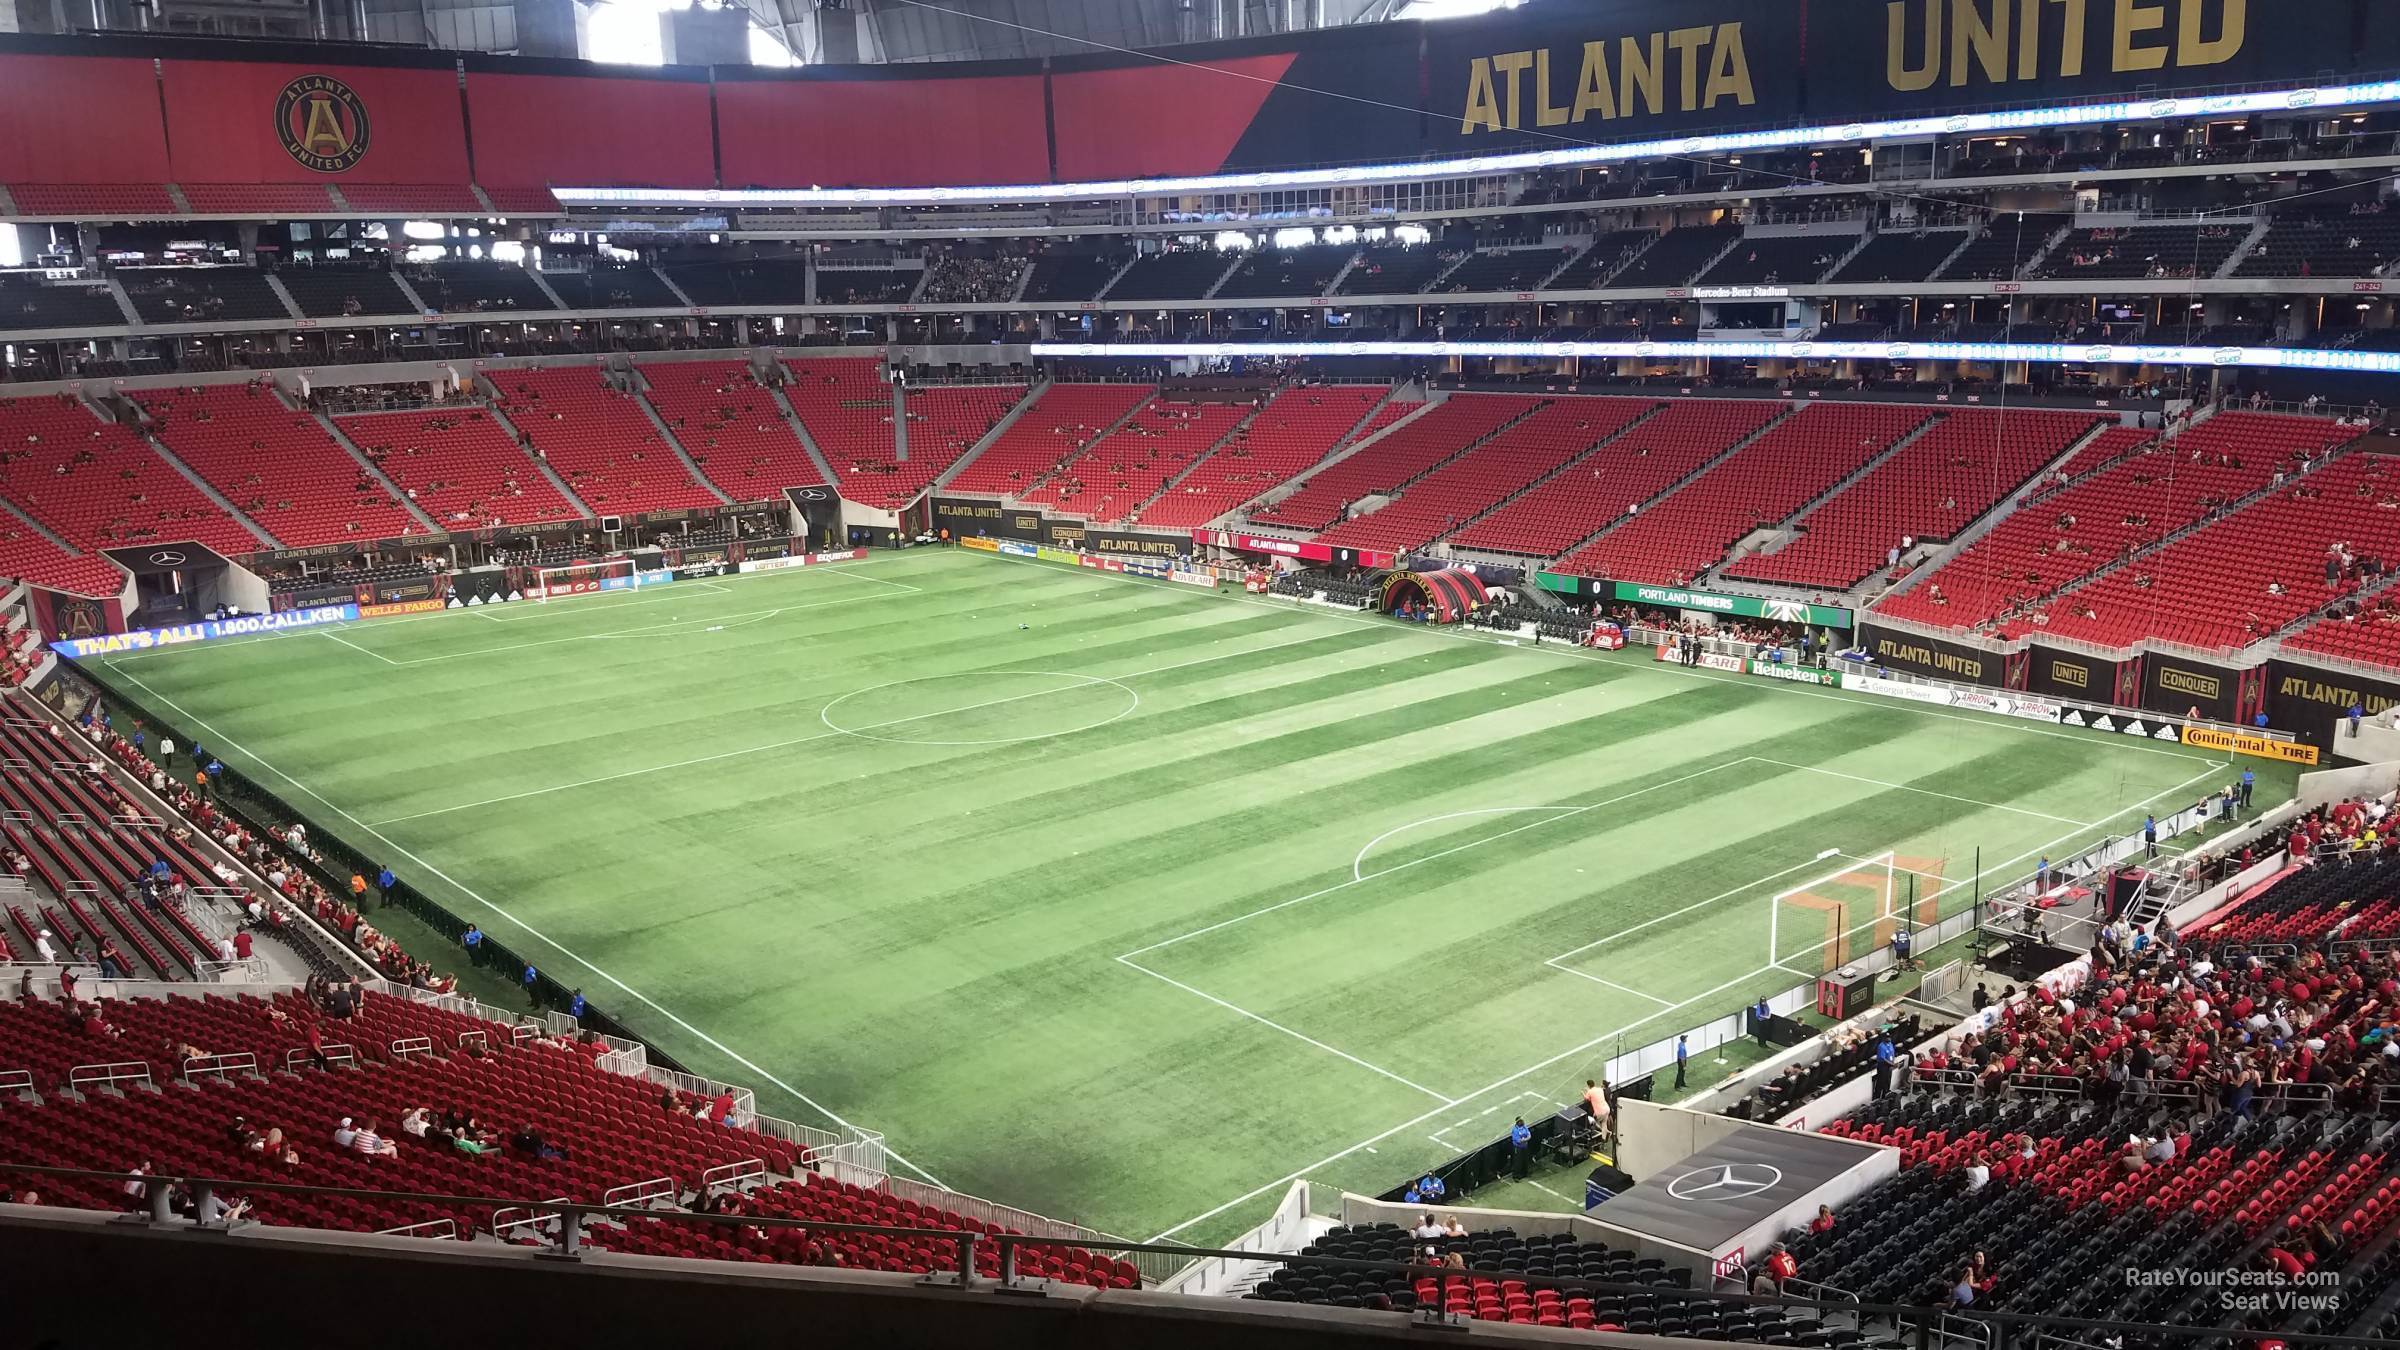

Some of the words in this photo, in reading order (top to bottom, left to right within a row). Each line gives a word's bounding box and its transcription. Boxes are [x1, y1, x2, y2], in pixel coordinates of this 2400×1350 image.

[1461, 22, 1755, 135] ATLANTA
[1887, 0, 2246, 92] UNITED
[286, 78, 352, 101] ATLANTA
[289, 142, 344, 170] UNITED
[346, 144, 362, 162] FC
[1692, 287, 1751, 298] Mercedes-Benz
[1753, 286, 1789, 297] Stadium
[2354, 282, 2382, 291] 241-242
[746, 502, 768, 511] UNITED
[938, 505, 973, 517] ATLANTA
[542, 523, 567, 532] UNITED
[1018, 519, 1036, 528] UNITE
[1053, 528, 1083, 539] CONQUER
[1099, 539, 1139, 552] ATLANTA
[1141, 541, 1176, 554] UNITED
[1249, 538, 1275, 551] ATLANTA
[274, 549, 309, 560] ATLANTA
[310, 545, 339, 556] UNITED
[817, 551, 855, 562] EQUIFAX
[1173, 570, 1214, 586] ADVOCARE
[1592, 581, 1601, 594] 0
[297, 598, 327, 607] ATLANTA
[328, 595, 353, 605] UNITED
[1638, 588, 1688, 604] PORTLAND
[1690, 594, 1733, 610] TIMBERS
[359, 604, 402, 617] WELLS
[405, 600, 444, 612] FARGO
[74, 630, 153, 656] THAT'S
[158, 624, 204, 645] ALL!
[213, 606, 345, 638] 1.800.CALL.KEN
[1877, 639, 1931, 665] ATLANTA
[1935, 653, 1982, 678] UNITED
[1752, 660, 1819, 683] Heineken
[2055, 664, 2086, 683] UNITE
[2163, 671, 2217, 695] CONQUER
[1872, 684, 1904, 698] Georgia
[1906, 687, 1932, 699] Power
[1961, 692, 1992, 706] ARROW
[2280, 676, 2359, 708] ATLANTA
[2020, 702, 2051, 714] ARROW
[2187, 729, 2265, 752] Continental
[2281, 746, 2314, 760] TIRE
[1720, 1252, 1742, 1277] 103
